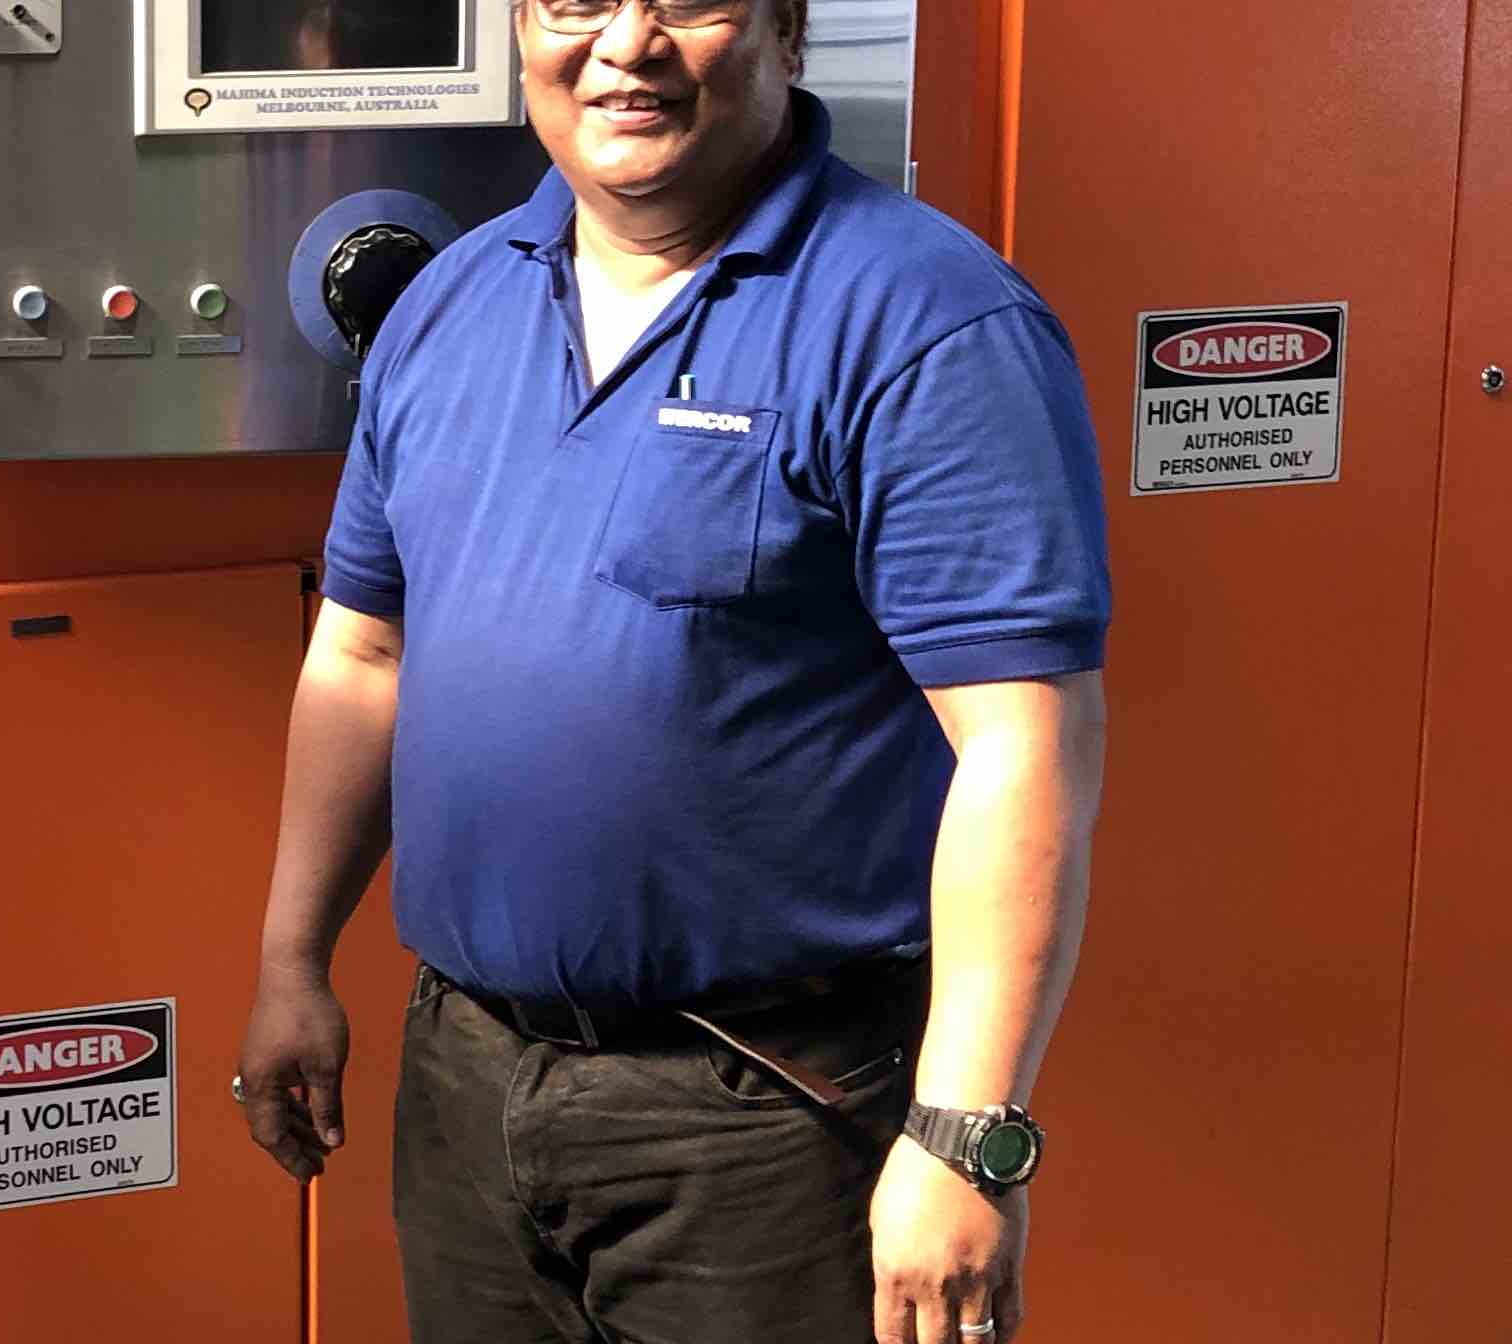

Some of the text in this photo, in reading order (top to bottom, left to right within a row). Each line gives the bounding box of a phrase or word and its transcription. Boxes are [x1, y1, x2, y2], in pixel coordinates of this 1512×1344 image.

[216, 84, 480, 100] MAHIMA INDUCTION TECHNOLOGIES
[256, 99, 439, 114] MELBOURNE, AUSTRALIA
[1179, 334, 1305, 367] DANGER
[1147, 391, 1330, 425] HIGH VOLTAGE
[1183, 428, 1293, 450] AUTHORISED
[1159, 451, 1313, 476] PERSONNEL ONLY
[23, 1091, 161, 1132] VOLTAGE
[90, 1156, 143, 1177] ONLY
